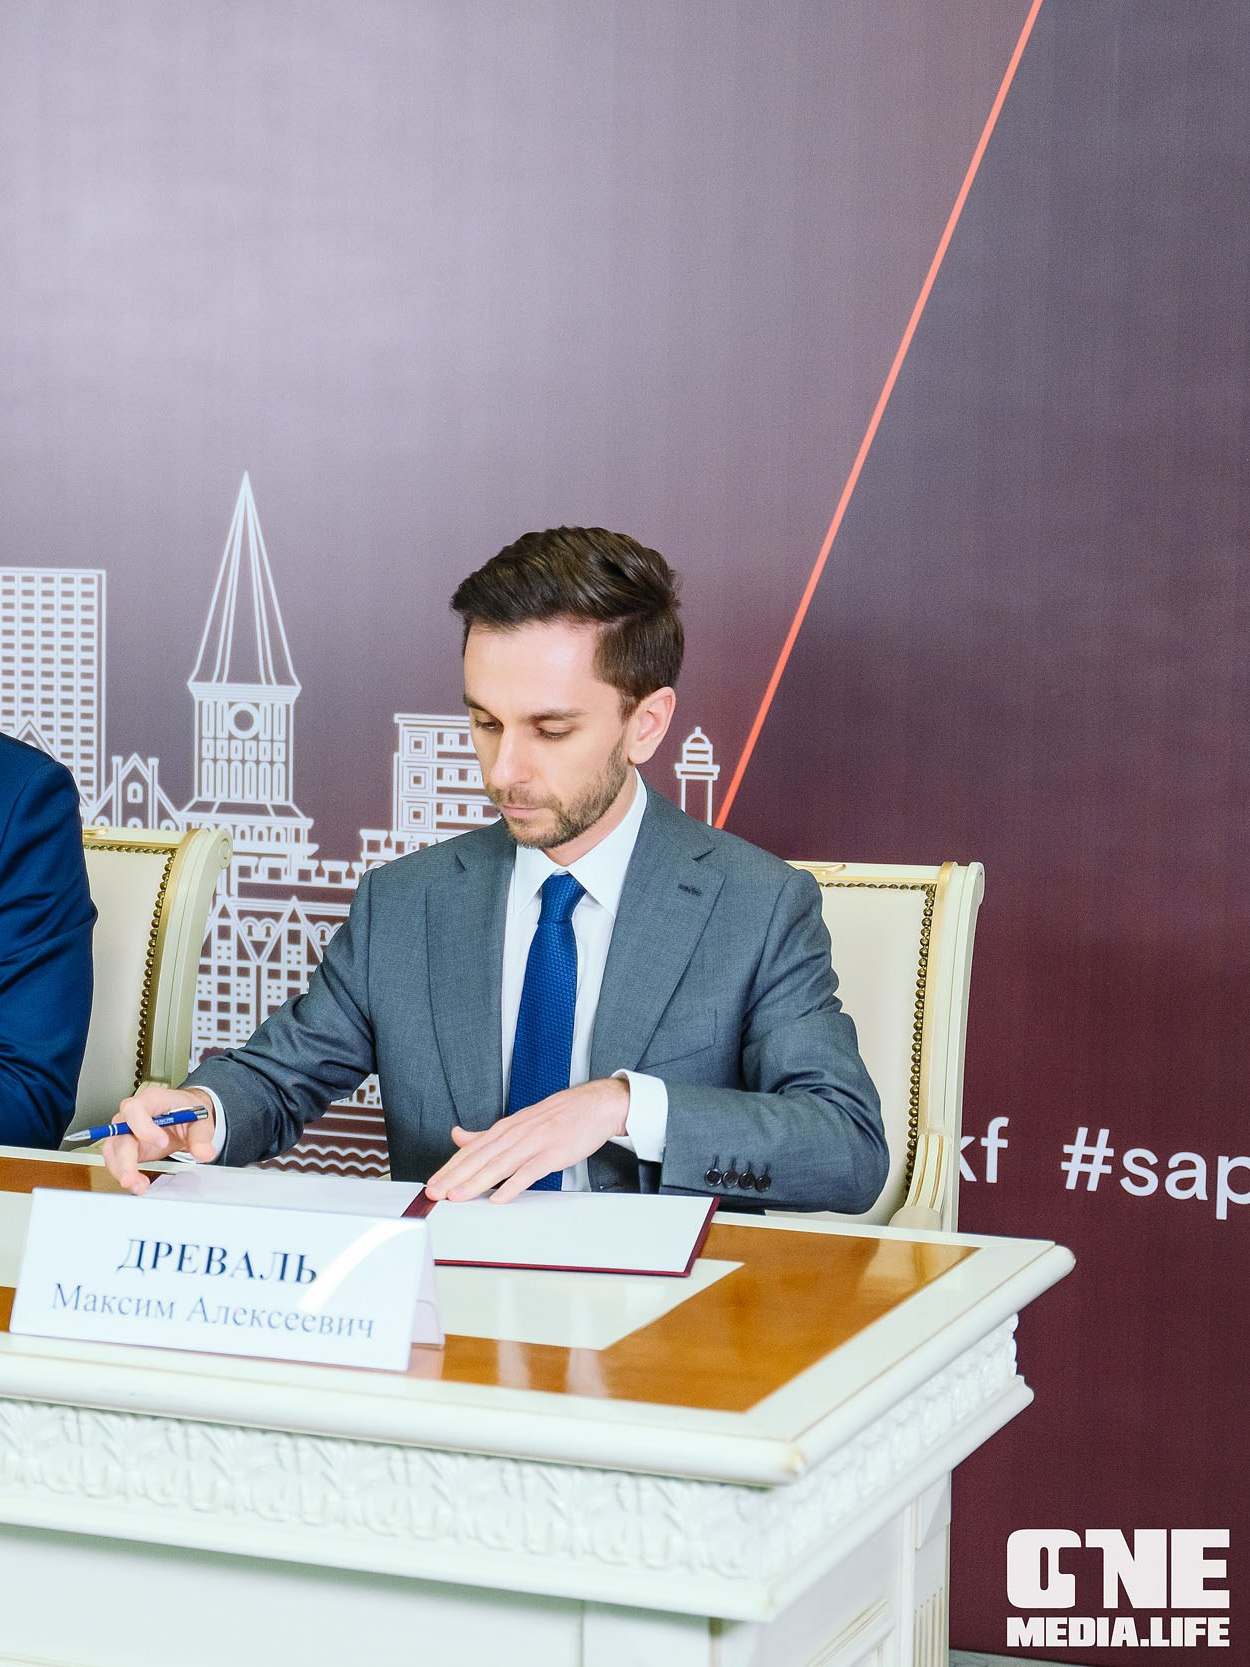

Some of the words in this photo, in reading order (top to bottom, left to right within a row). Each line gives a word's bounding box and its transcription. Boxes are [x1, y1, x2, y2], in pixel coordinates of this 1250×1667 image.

[1060, 1126, 1250, 1221] #sap
[117, 1239, 318, 1284] ДРЕВАЛЬ
[52, 1282, 175, 1320] Максим
[186, 1297, 374, 1338] Алексеевич
